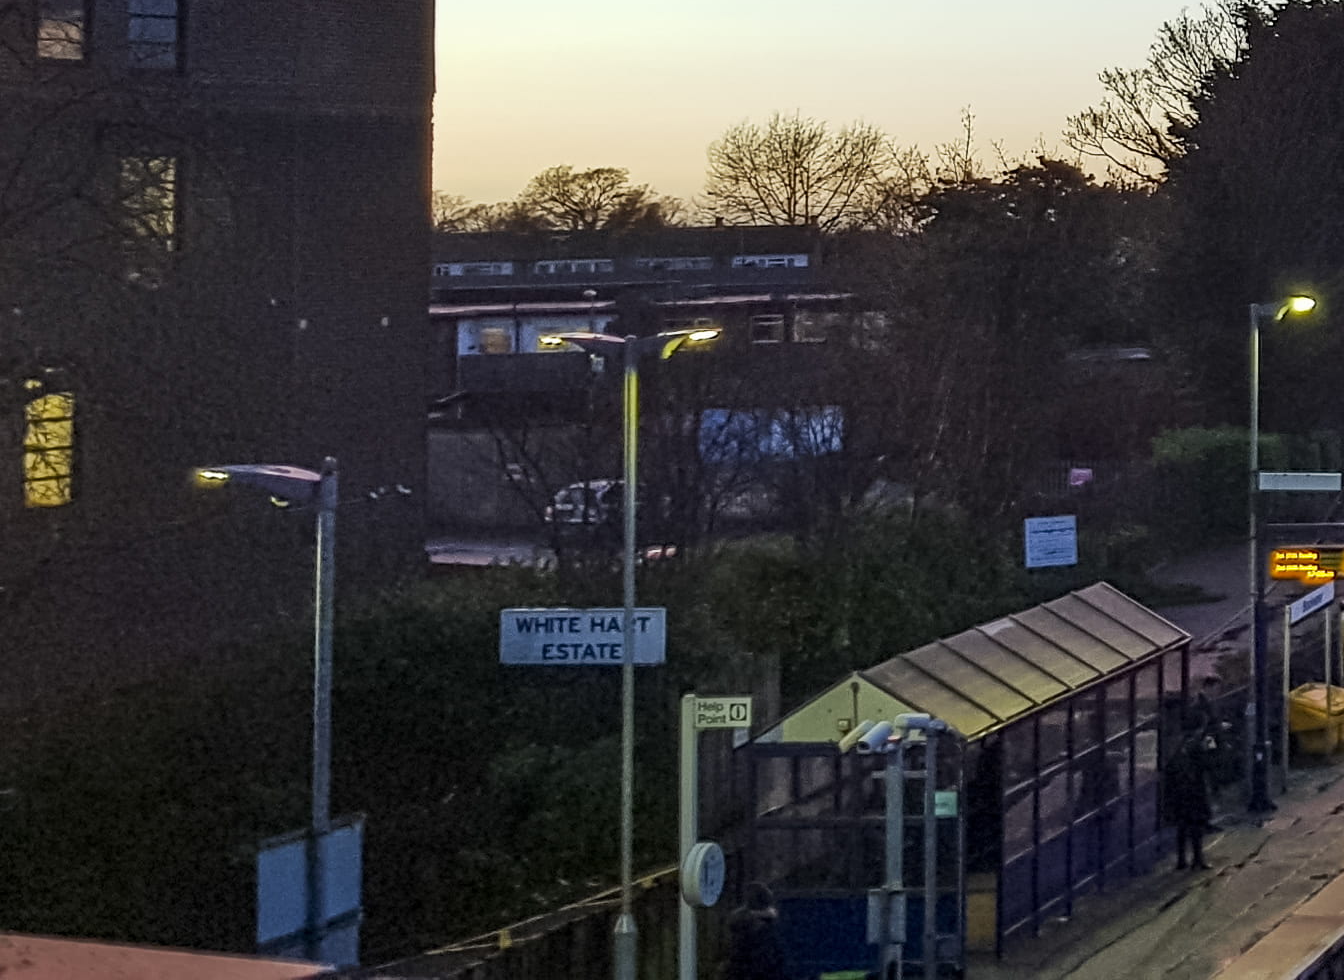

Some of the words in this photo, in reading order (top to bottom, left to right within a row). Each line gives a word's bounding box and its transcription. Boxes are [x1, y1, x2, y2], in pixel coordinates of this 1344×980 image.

[516, 617, 581, 633] WHITE
[590, 617, 651, 633] HAT
[541, 643, 623, 660] ESTATE
[698, 701, 724, 713] Help
[698, 713, 727, 724] Point
